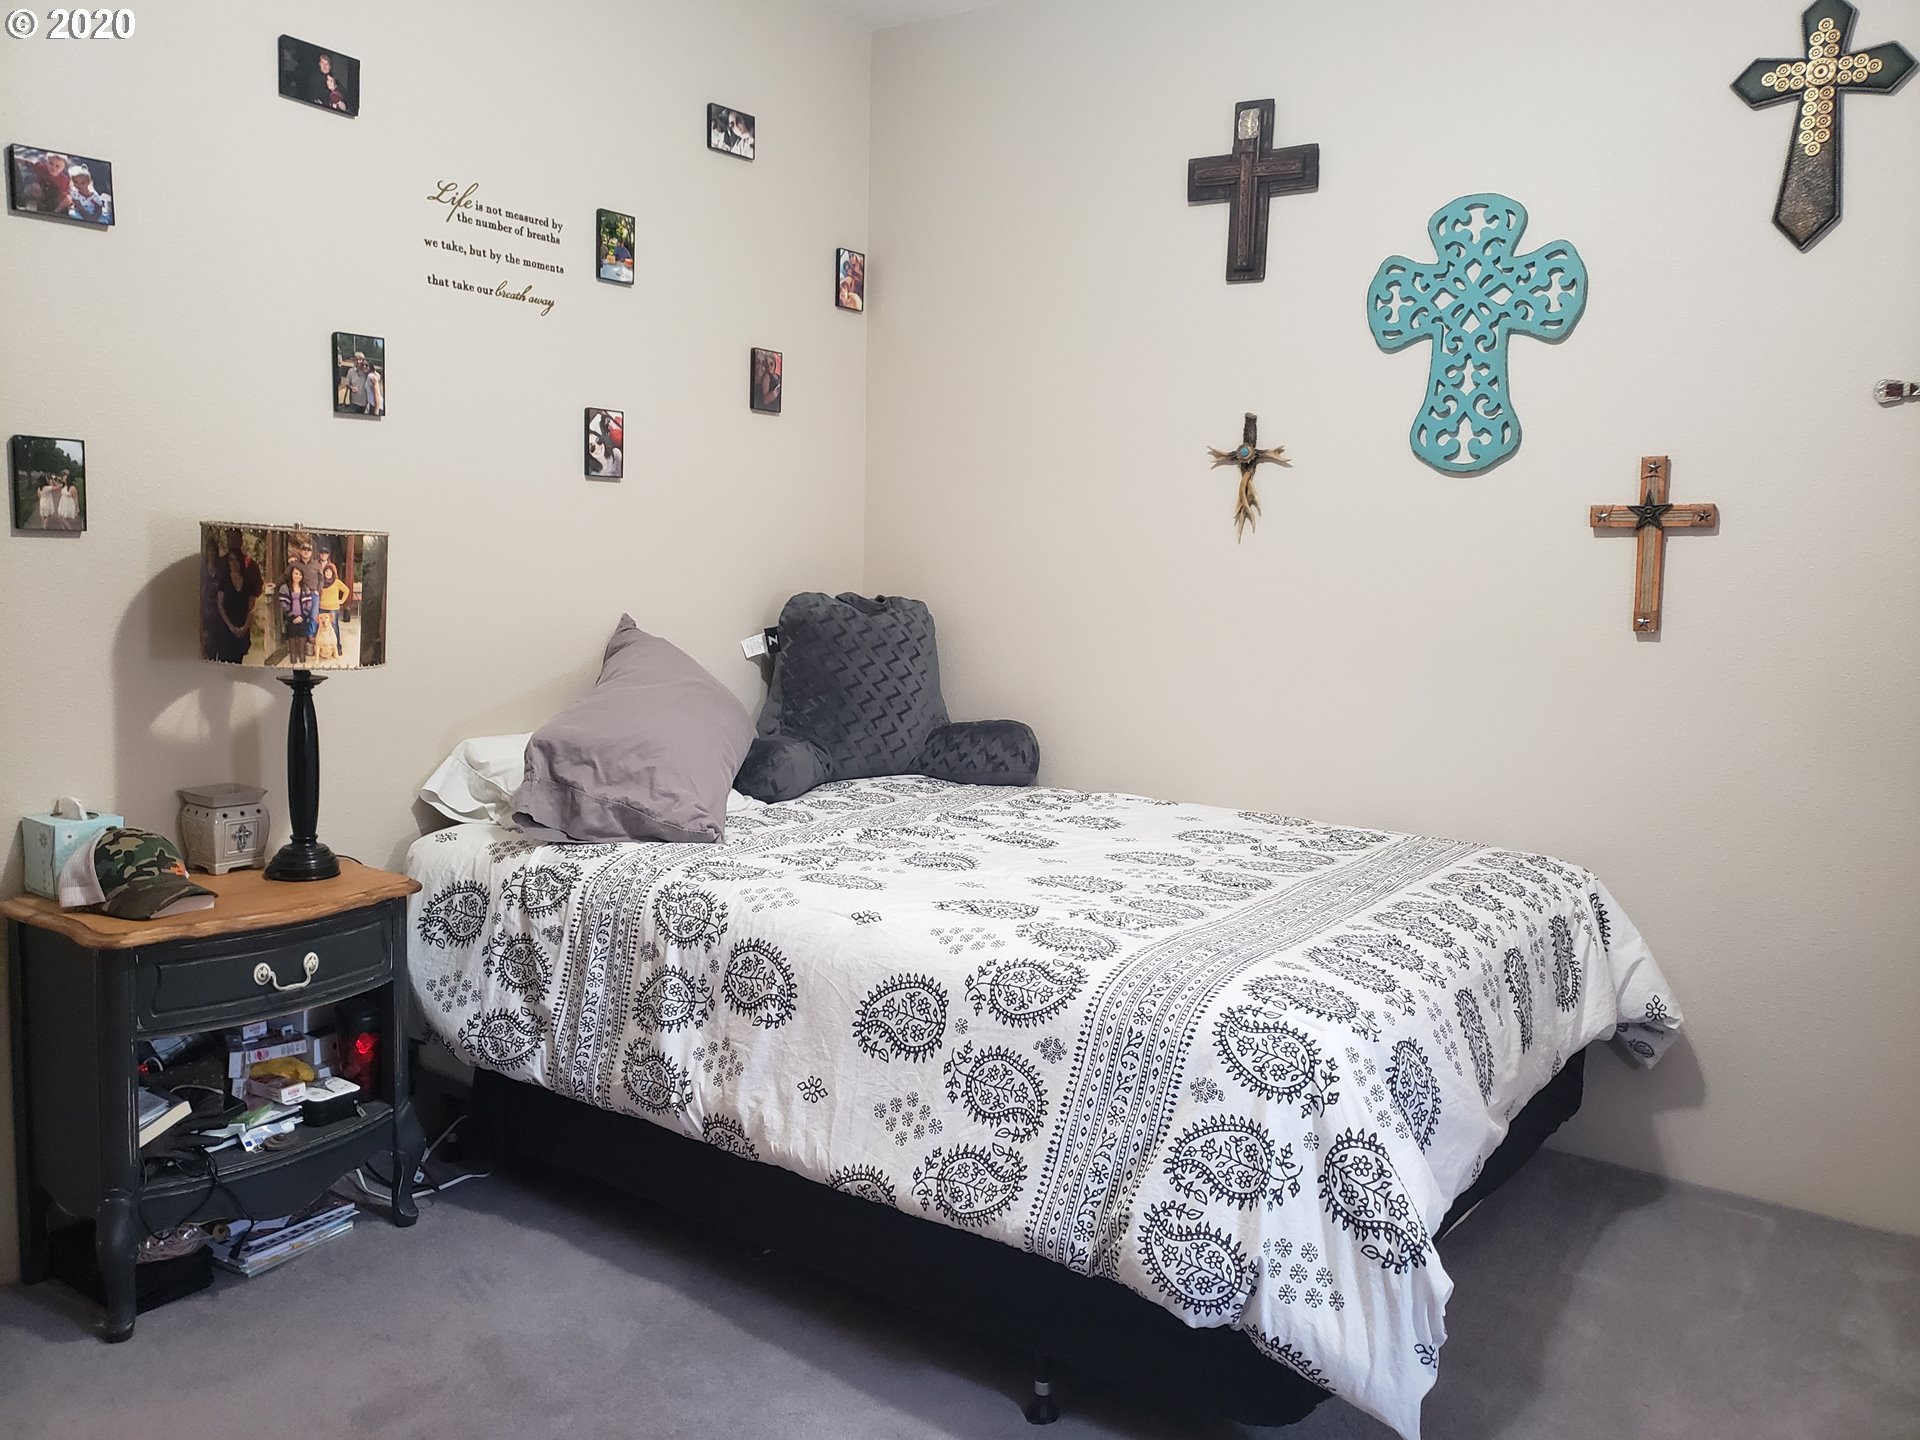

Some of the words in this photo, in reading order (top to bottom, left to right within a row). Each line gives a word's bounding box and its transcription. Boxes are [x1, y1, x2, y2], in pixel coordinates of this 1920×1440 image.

[427, 180, 479, 223] Life
[475, 200, 484, 213] is
[486, 206, 503, 217] not
[505, 211, 549, 228] measured
[552, 219, 564, 234] by
[457, 211, 474, 225] the
[475, 218, 513, 234] number
[514, 226, 526, 237] of
[527, 227, 561, 246] breaths
[424, 238, 439, 248] we
[441, 240, 468, 256] take,
[469, 244, 487, 258] but
[490, 249, 502, 264] by
[505, 253, 521, 266] the
[523, 258, 565, 275] moments
[427, 273, 450, 288] that
[452, 280, 475, 293] take
[477, 285, 495, 296] our
[495, 280, 533, 302] breath
[528, 297, 555, 317] away
